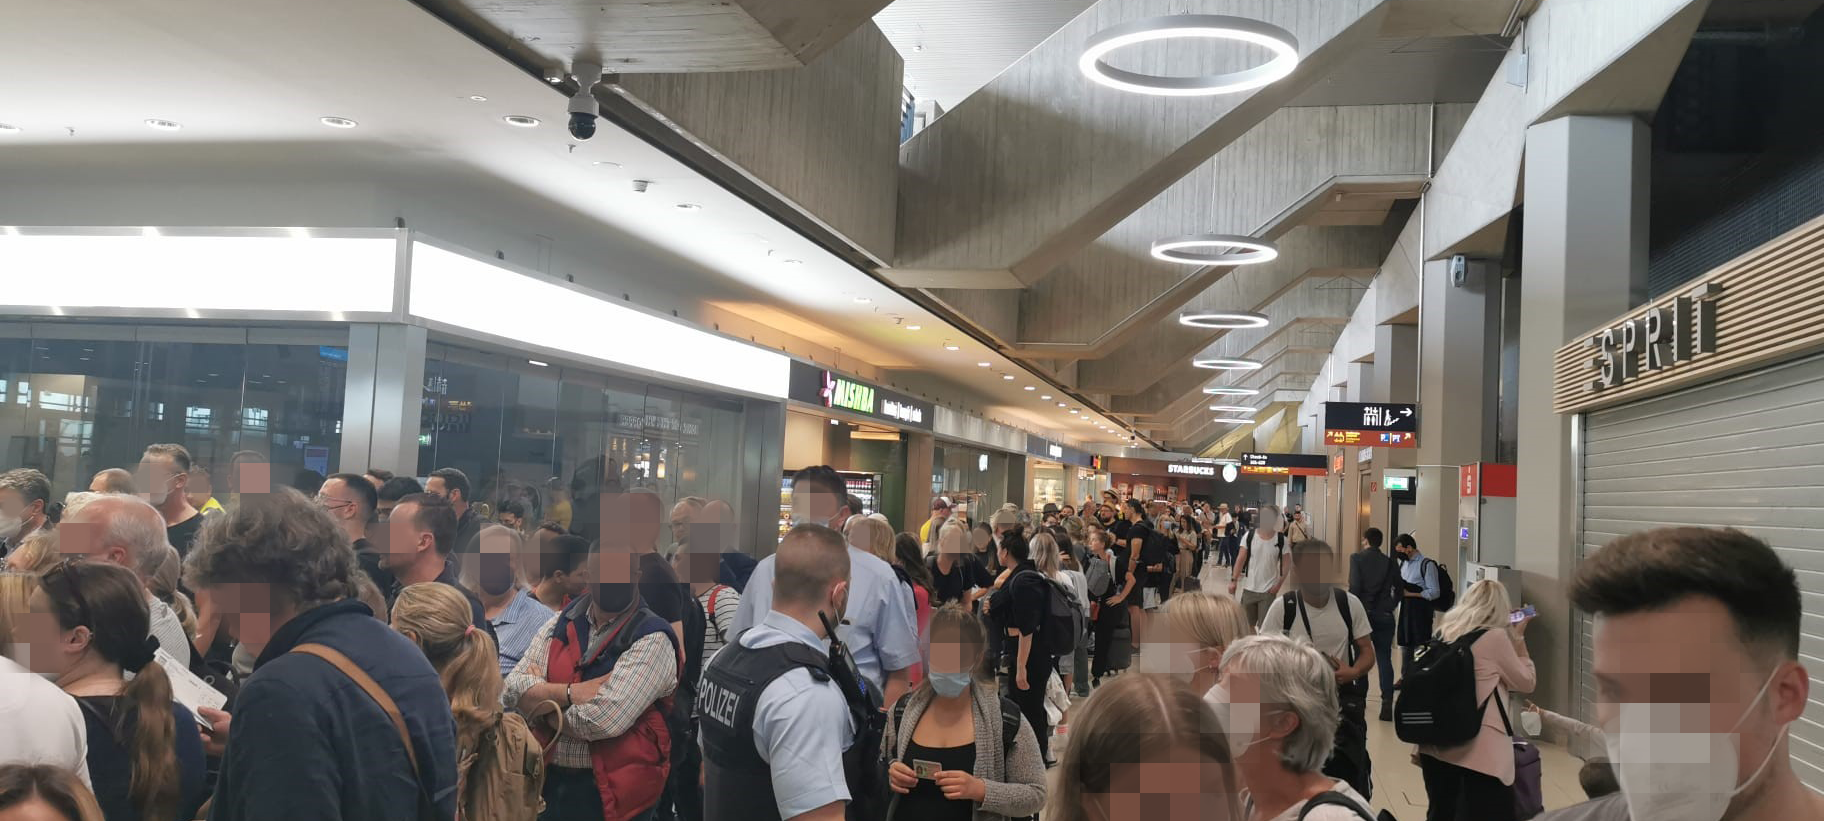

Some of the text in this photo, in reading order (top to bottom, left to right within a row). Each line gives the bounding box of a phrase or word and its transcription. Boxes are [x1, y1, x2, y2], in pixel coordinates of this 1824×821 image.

[1582, 281, 1726, 393] ESPRIT
[1167, 464, 1215, 476] STARBUCKS
[698, 678, 741, 729] POLIZEI
